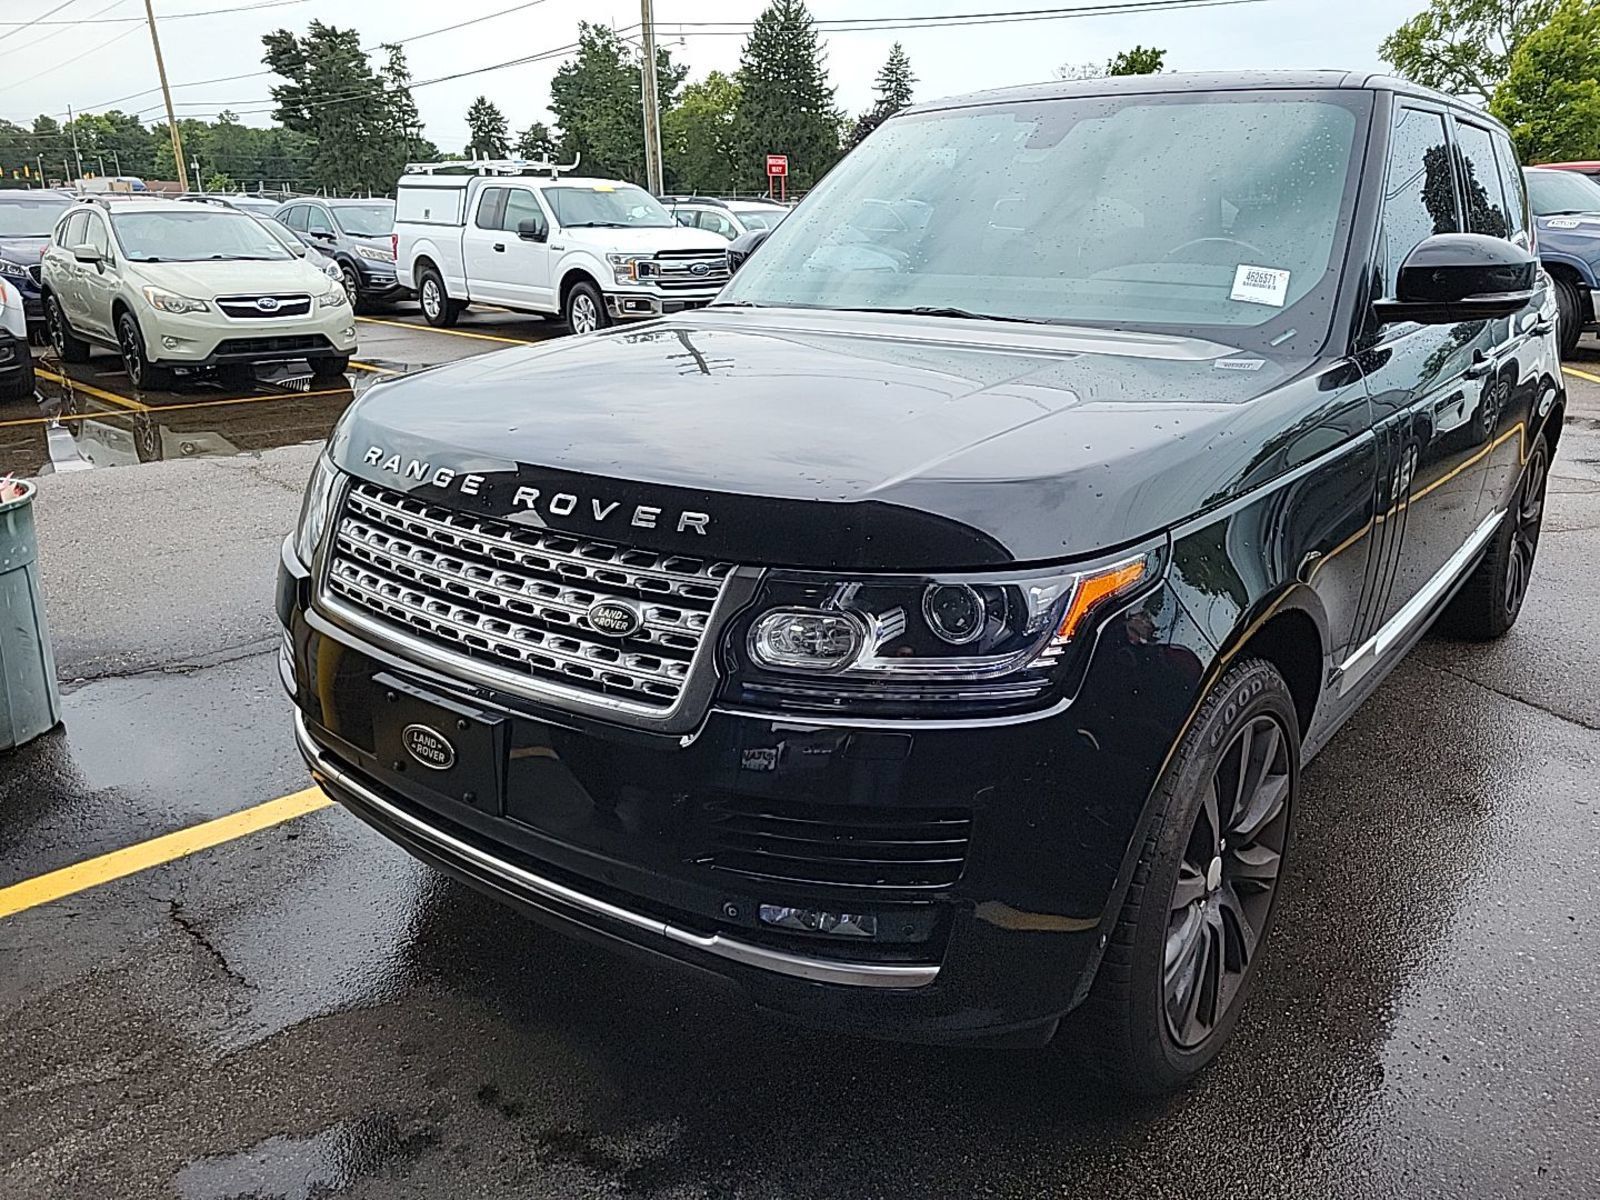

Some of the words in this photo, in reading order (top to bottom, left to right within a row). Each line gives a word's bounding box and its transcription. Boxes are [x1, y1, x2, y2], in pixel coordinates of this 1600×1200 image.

[363, 446, 485, 495] RANGE
[512, 486, 710, 535] ROVER
[598, 607, 623, 620] LAND
[598, 618, 628, 630] ROVER
[413, 732, 437, 748] LAND
[416, 743, 445, 763] ROVER
